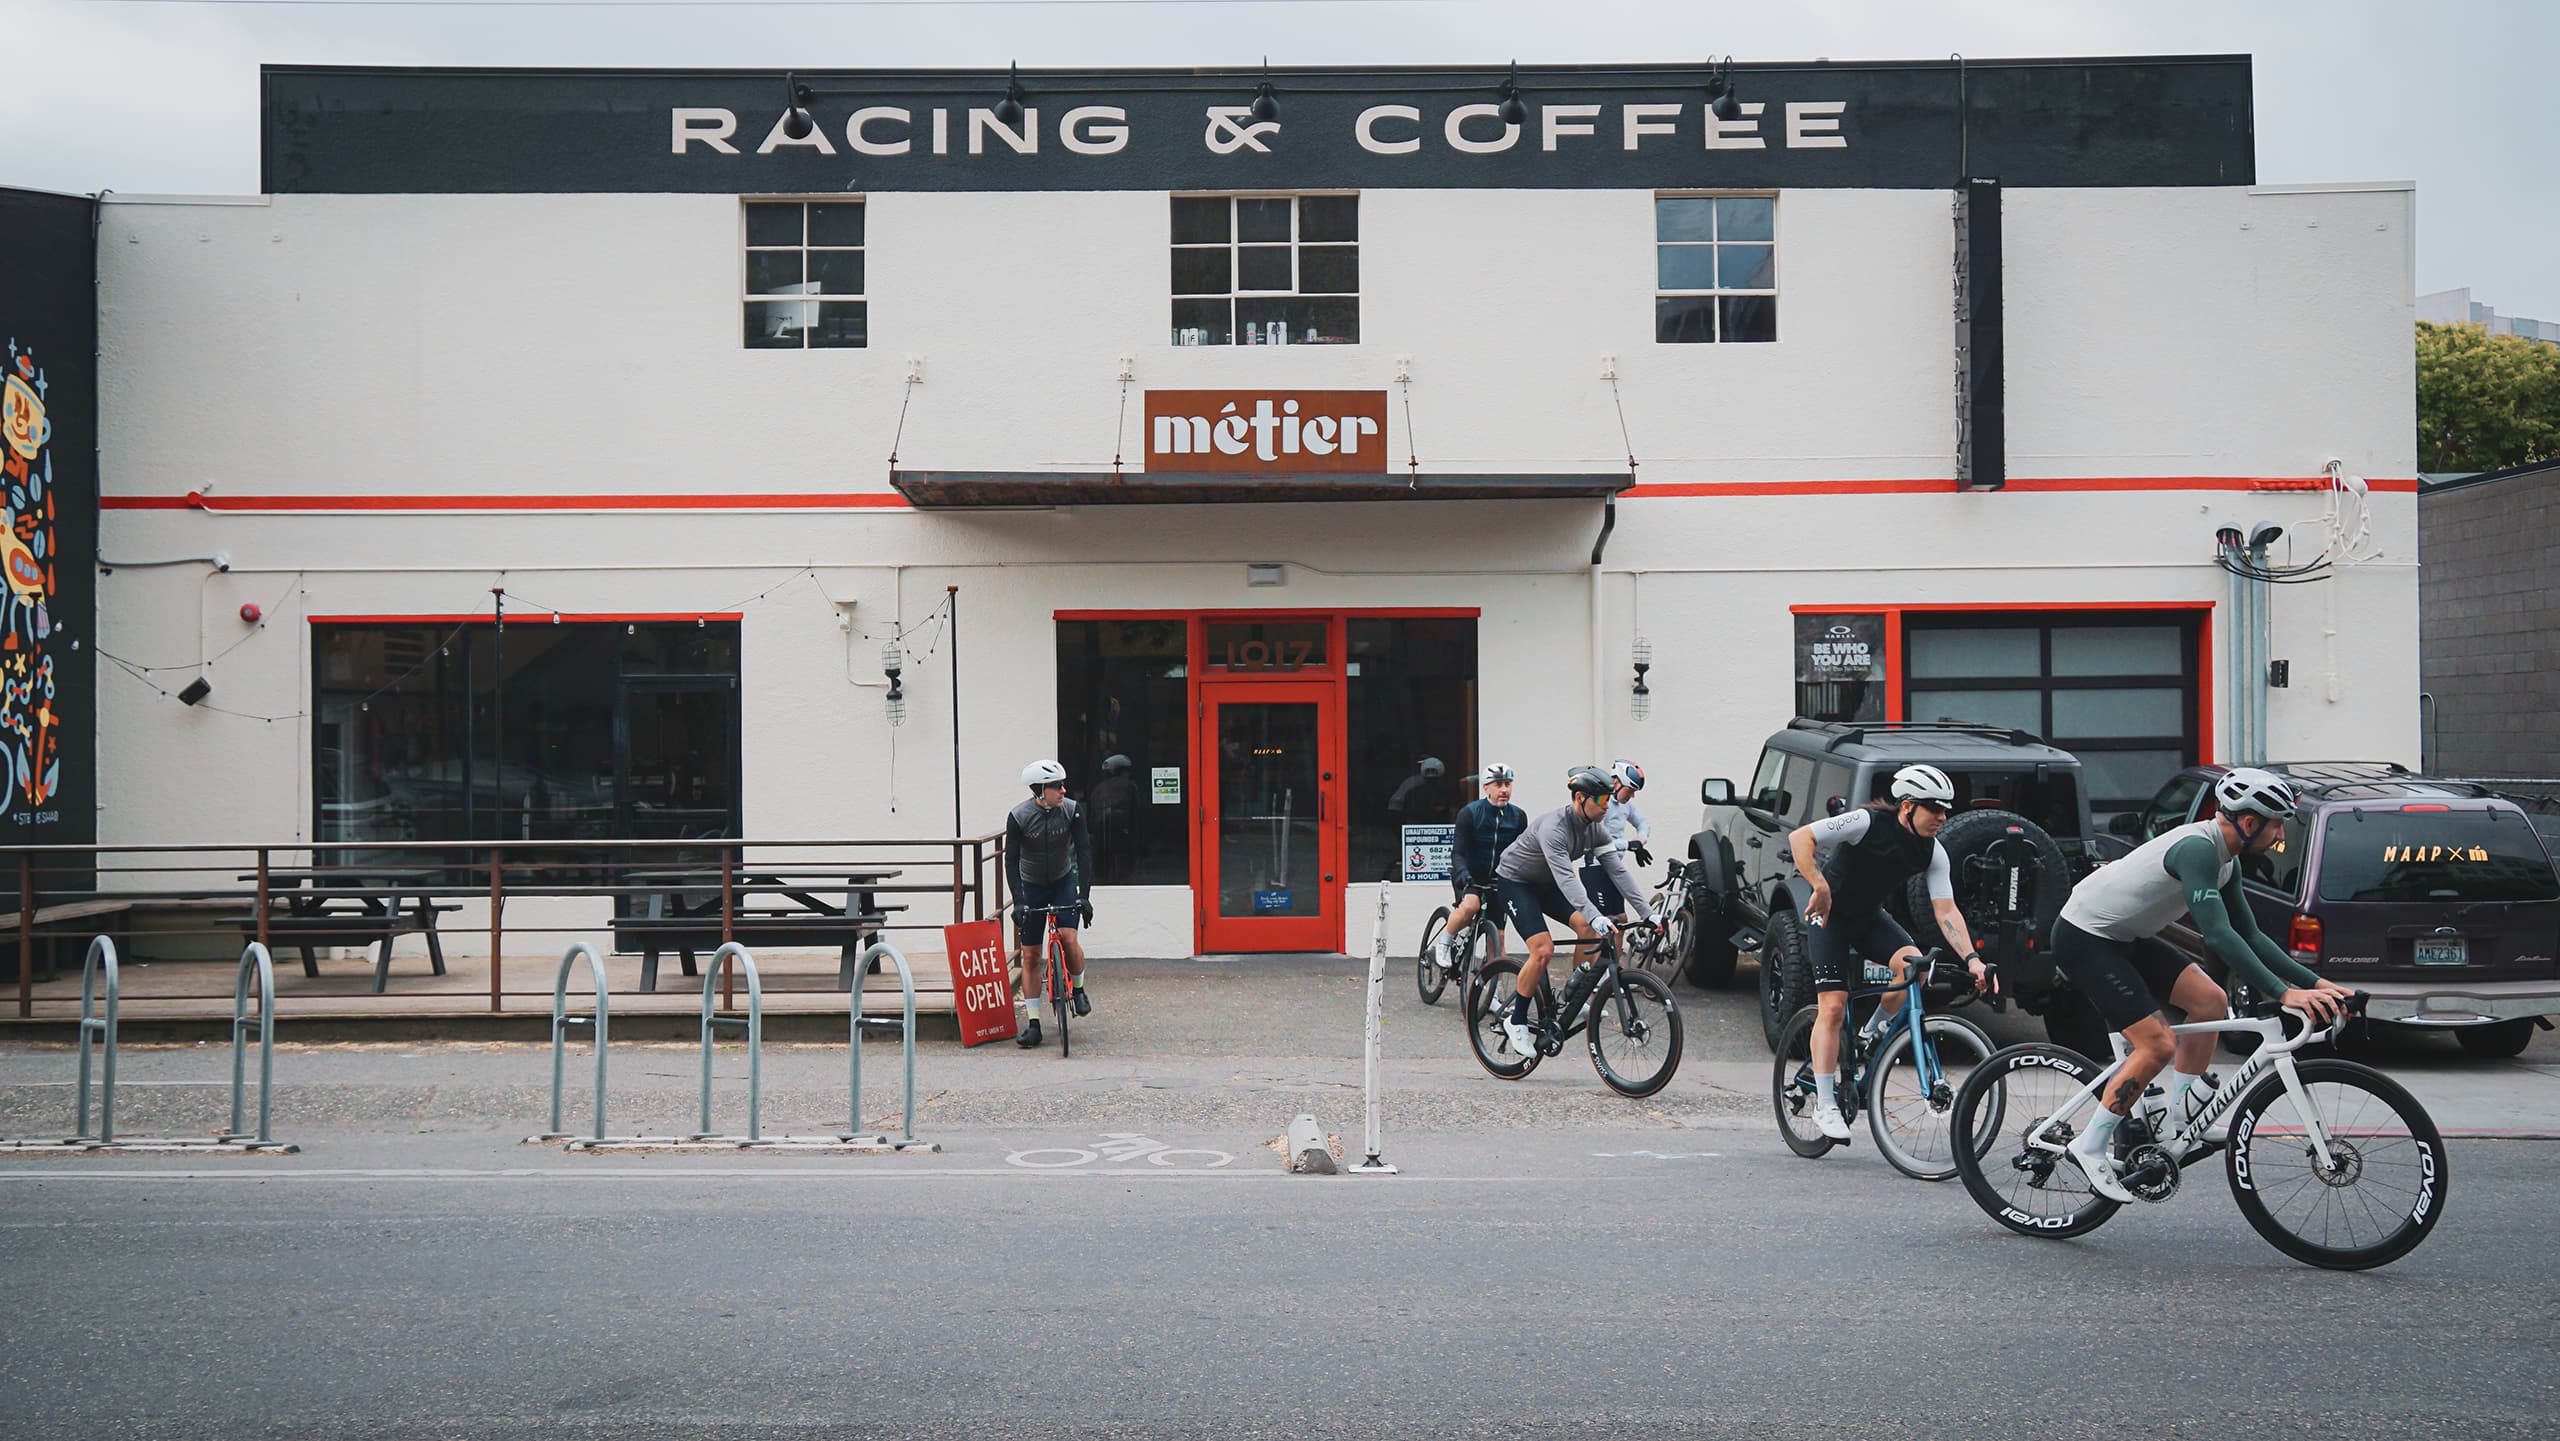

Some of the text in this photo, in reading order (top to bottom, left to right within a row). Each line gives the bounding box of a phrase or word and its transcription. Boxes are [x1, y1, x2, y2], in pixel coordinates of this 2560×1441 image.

[671, 101, 1848, 155] RACING & COFFEE
[1154, 399, 1378, 462] métier
[1226, 640, 1313, 673] 1017
[1811, 654, 1870, 665] YOU ARE
[1814, 643, 1868, 654] BE WHO
[2383, 845, 2441, 862] MAAP
[2009, 866, 2019, 911] YAKIMA
[960, 940, 1000, 978] CAFÉ
[2328, 956, 2380, 964] EXPLORER
[965, 980, 1005, 1011] OPEN
[2009, 1055, 2083, 1076] roval
[2181, 1059, 2259, 1149] SPECIALIZED
[2235, 1108, 2256, 1190] roval
[2411, 1140, 2435, 1225] roval
[1999, 1206, 2075, 1229] roval
